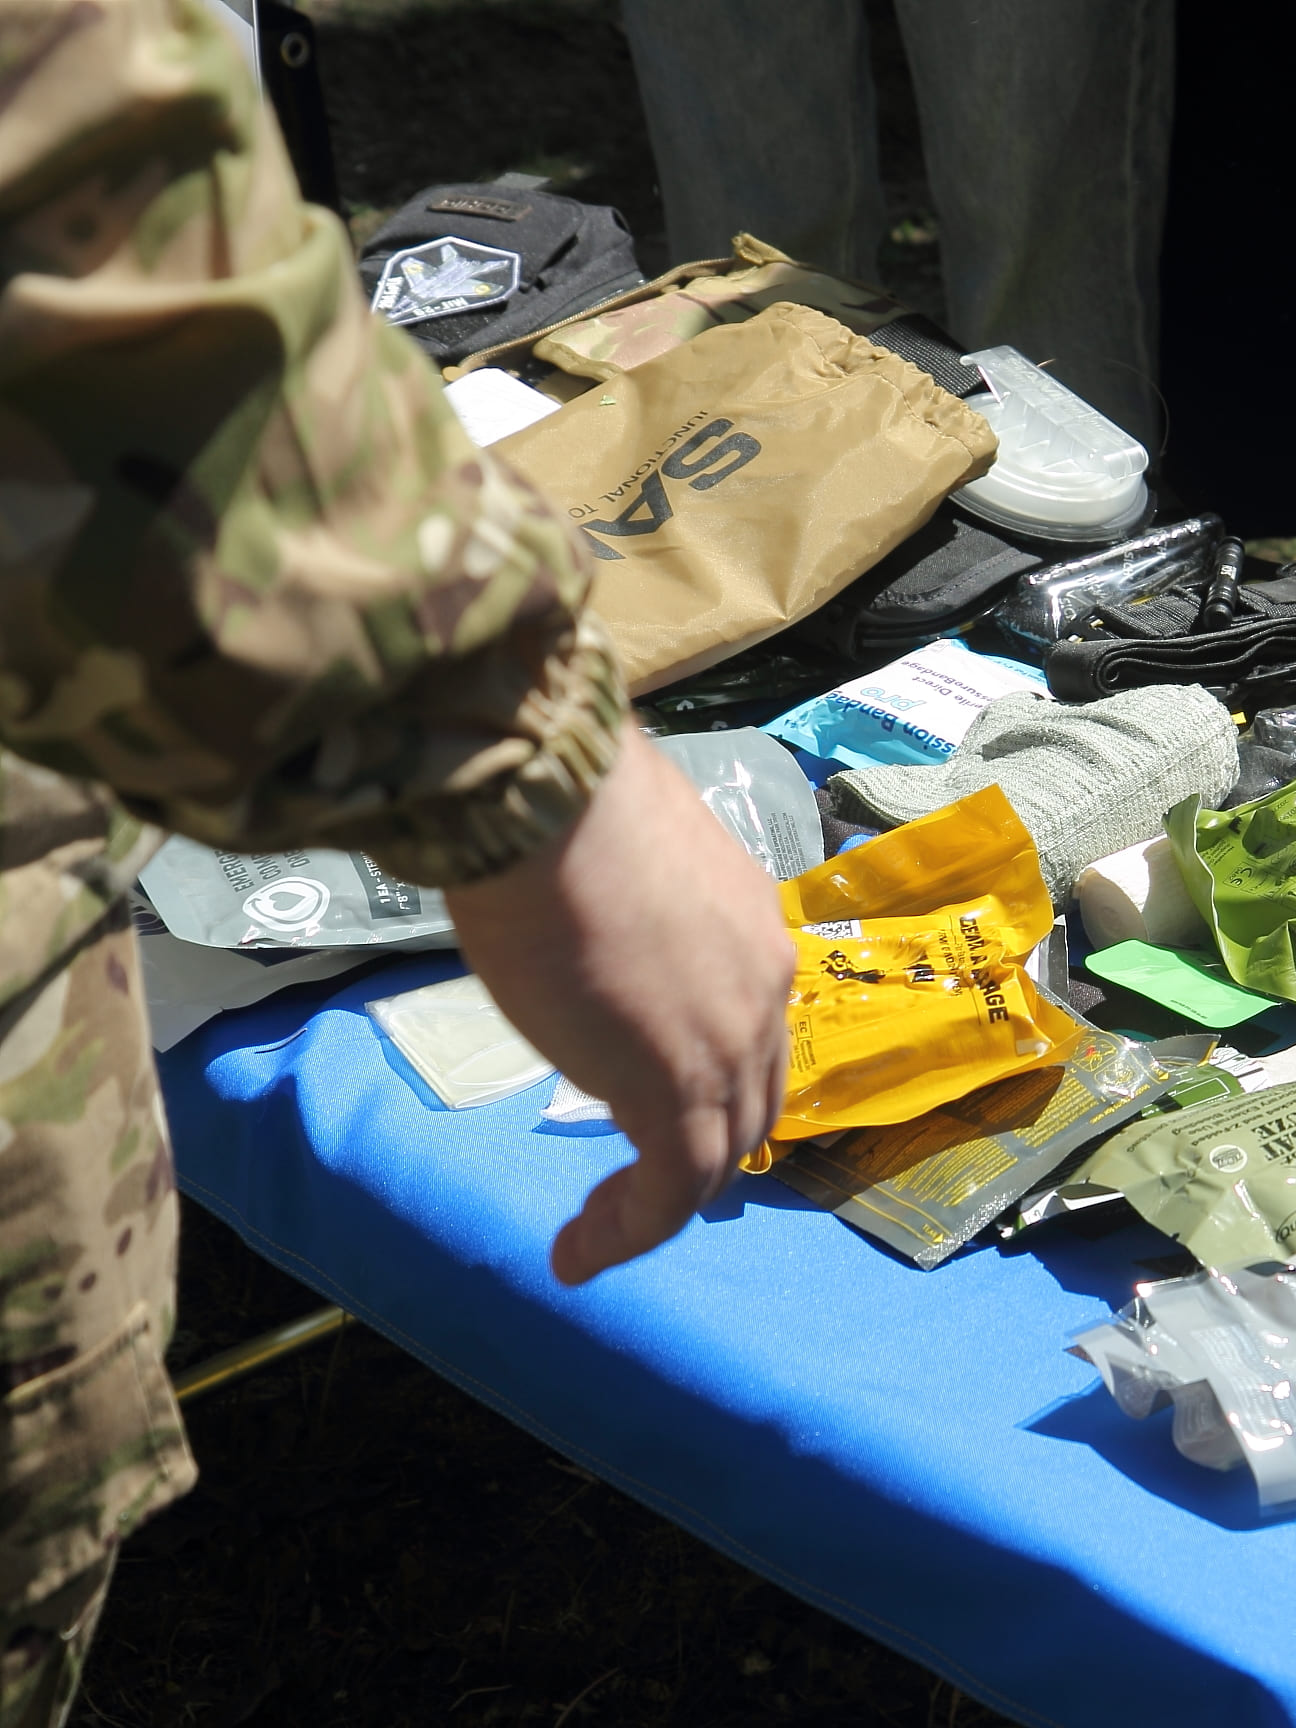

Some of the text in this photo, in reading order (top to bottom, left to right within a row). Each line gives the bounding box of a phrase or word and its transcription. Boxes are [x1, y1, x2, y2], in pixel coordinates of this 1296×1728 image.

[566, 500, 599, 522] TO
[900, 660, 996, 704] essureBandage
[911, 676, 952, 698] Direct
[859, 686, 926, 713] pro
[903, 721, 958, 755] ssion
[1213, 1105, 1260, 1128] External
